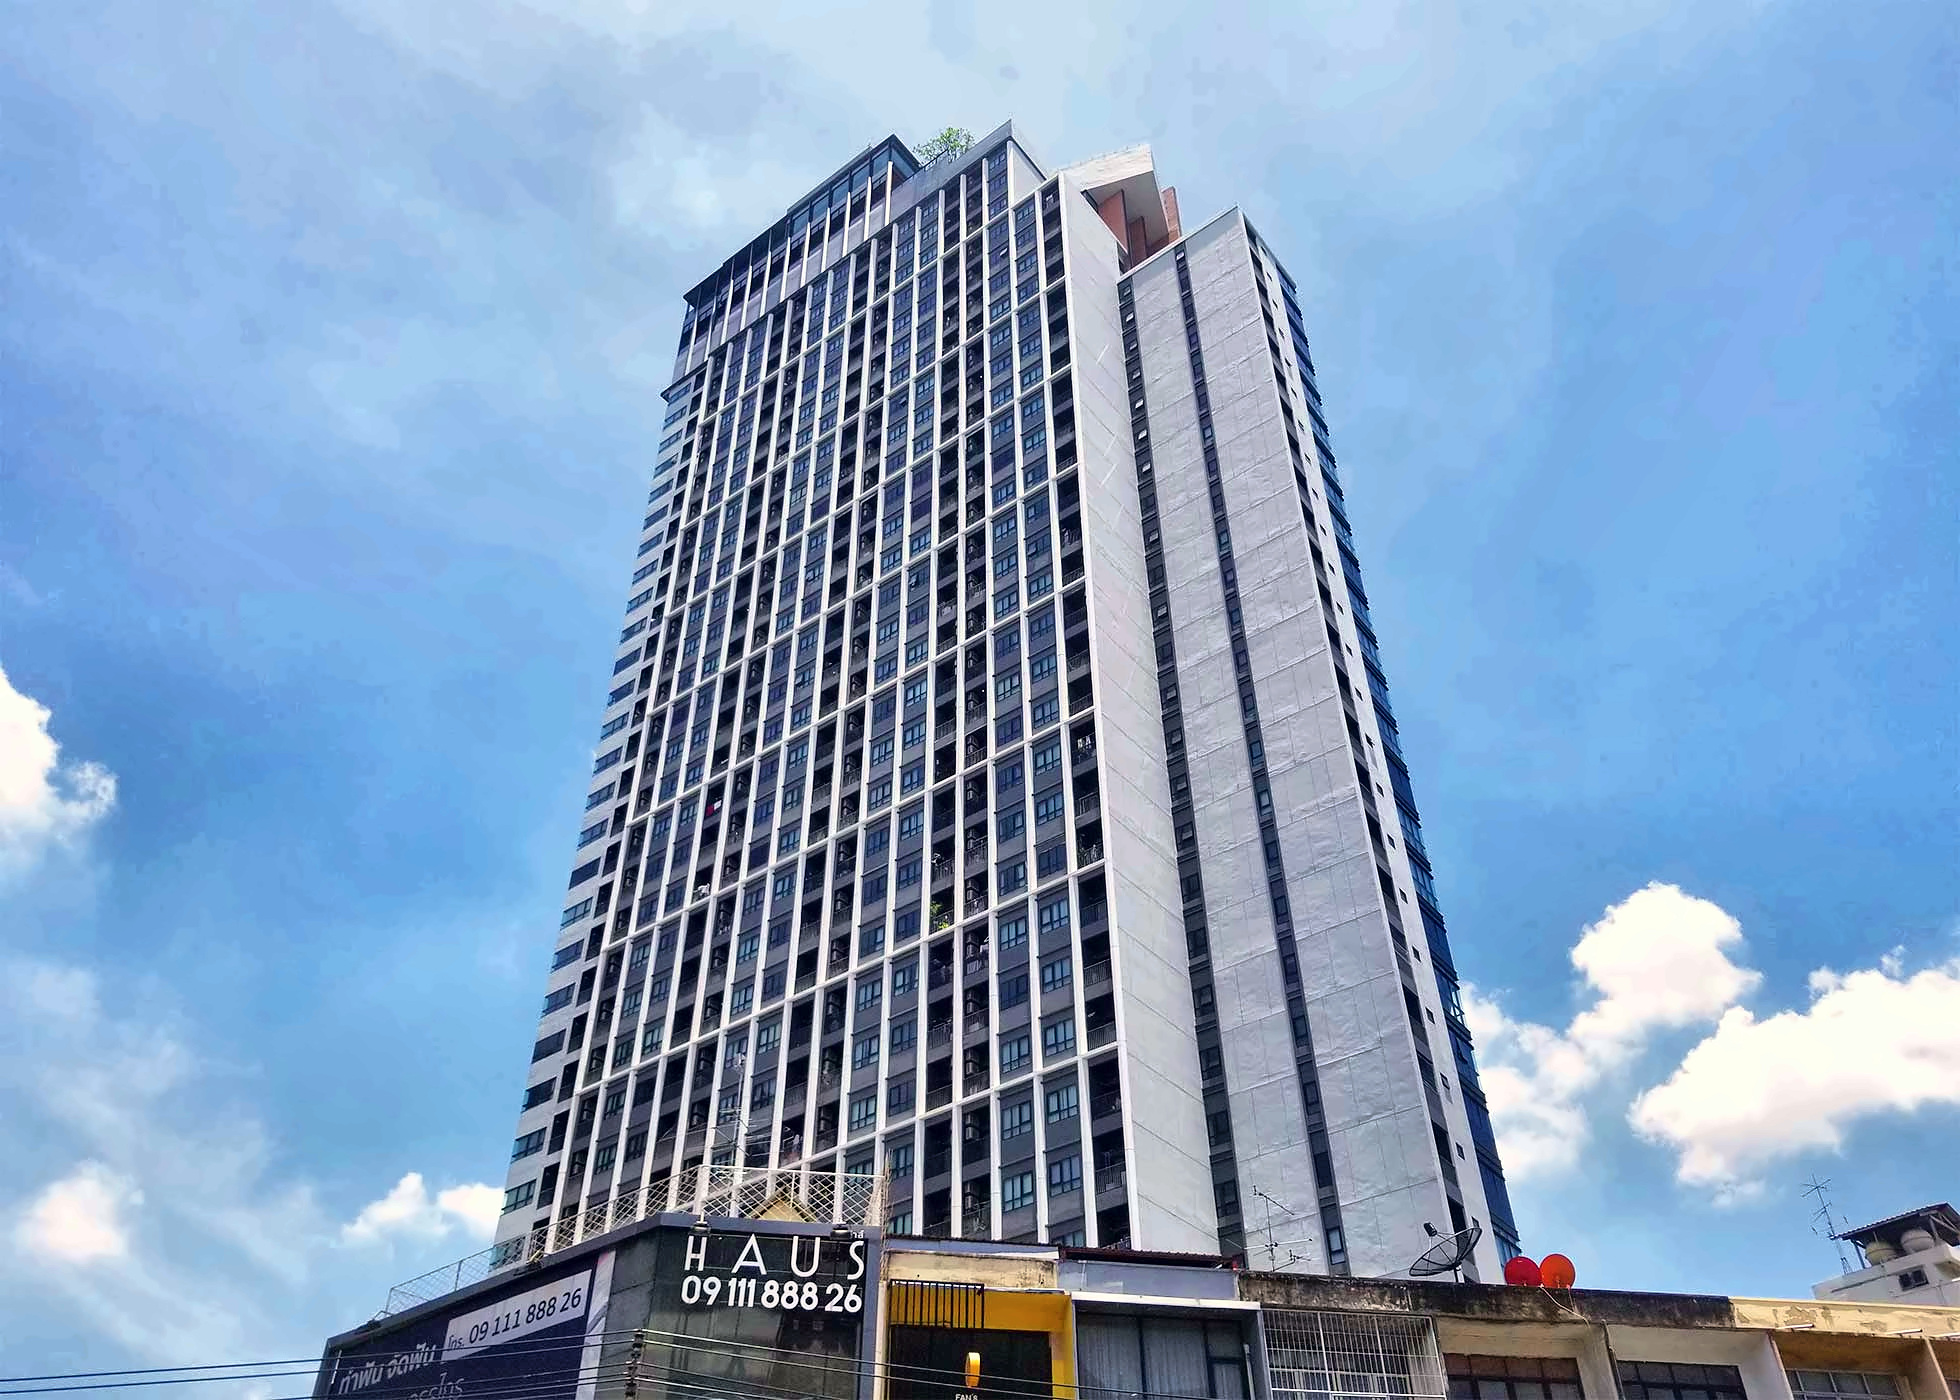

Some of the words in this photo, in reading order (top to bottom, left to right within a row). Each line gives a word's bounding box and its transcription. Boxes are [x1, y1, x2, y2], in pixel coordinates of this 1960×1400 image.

[684, 1233, 864, 1280] HAUS
[469, 1321, 489, 1344] 09
[491, 1309, 521, 1337] 111
[525, 1296, 557, 1324] 888
[559, 1287, 582, 1313] 26
[681, 1275, 722, 1306] 09
[728, 1277, 757, 1308] 111
[761, 1280, 819, 1311] 888
[824, 1283, 863, 1314] 26
[339, 1361, 384, 1395] ทำฟัน
[386, 1342, 437, 1380] จัดฟัน
